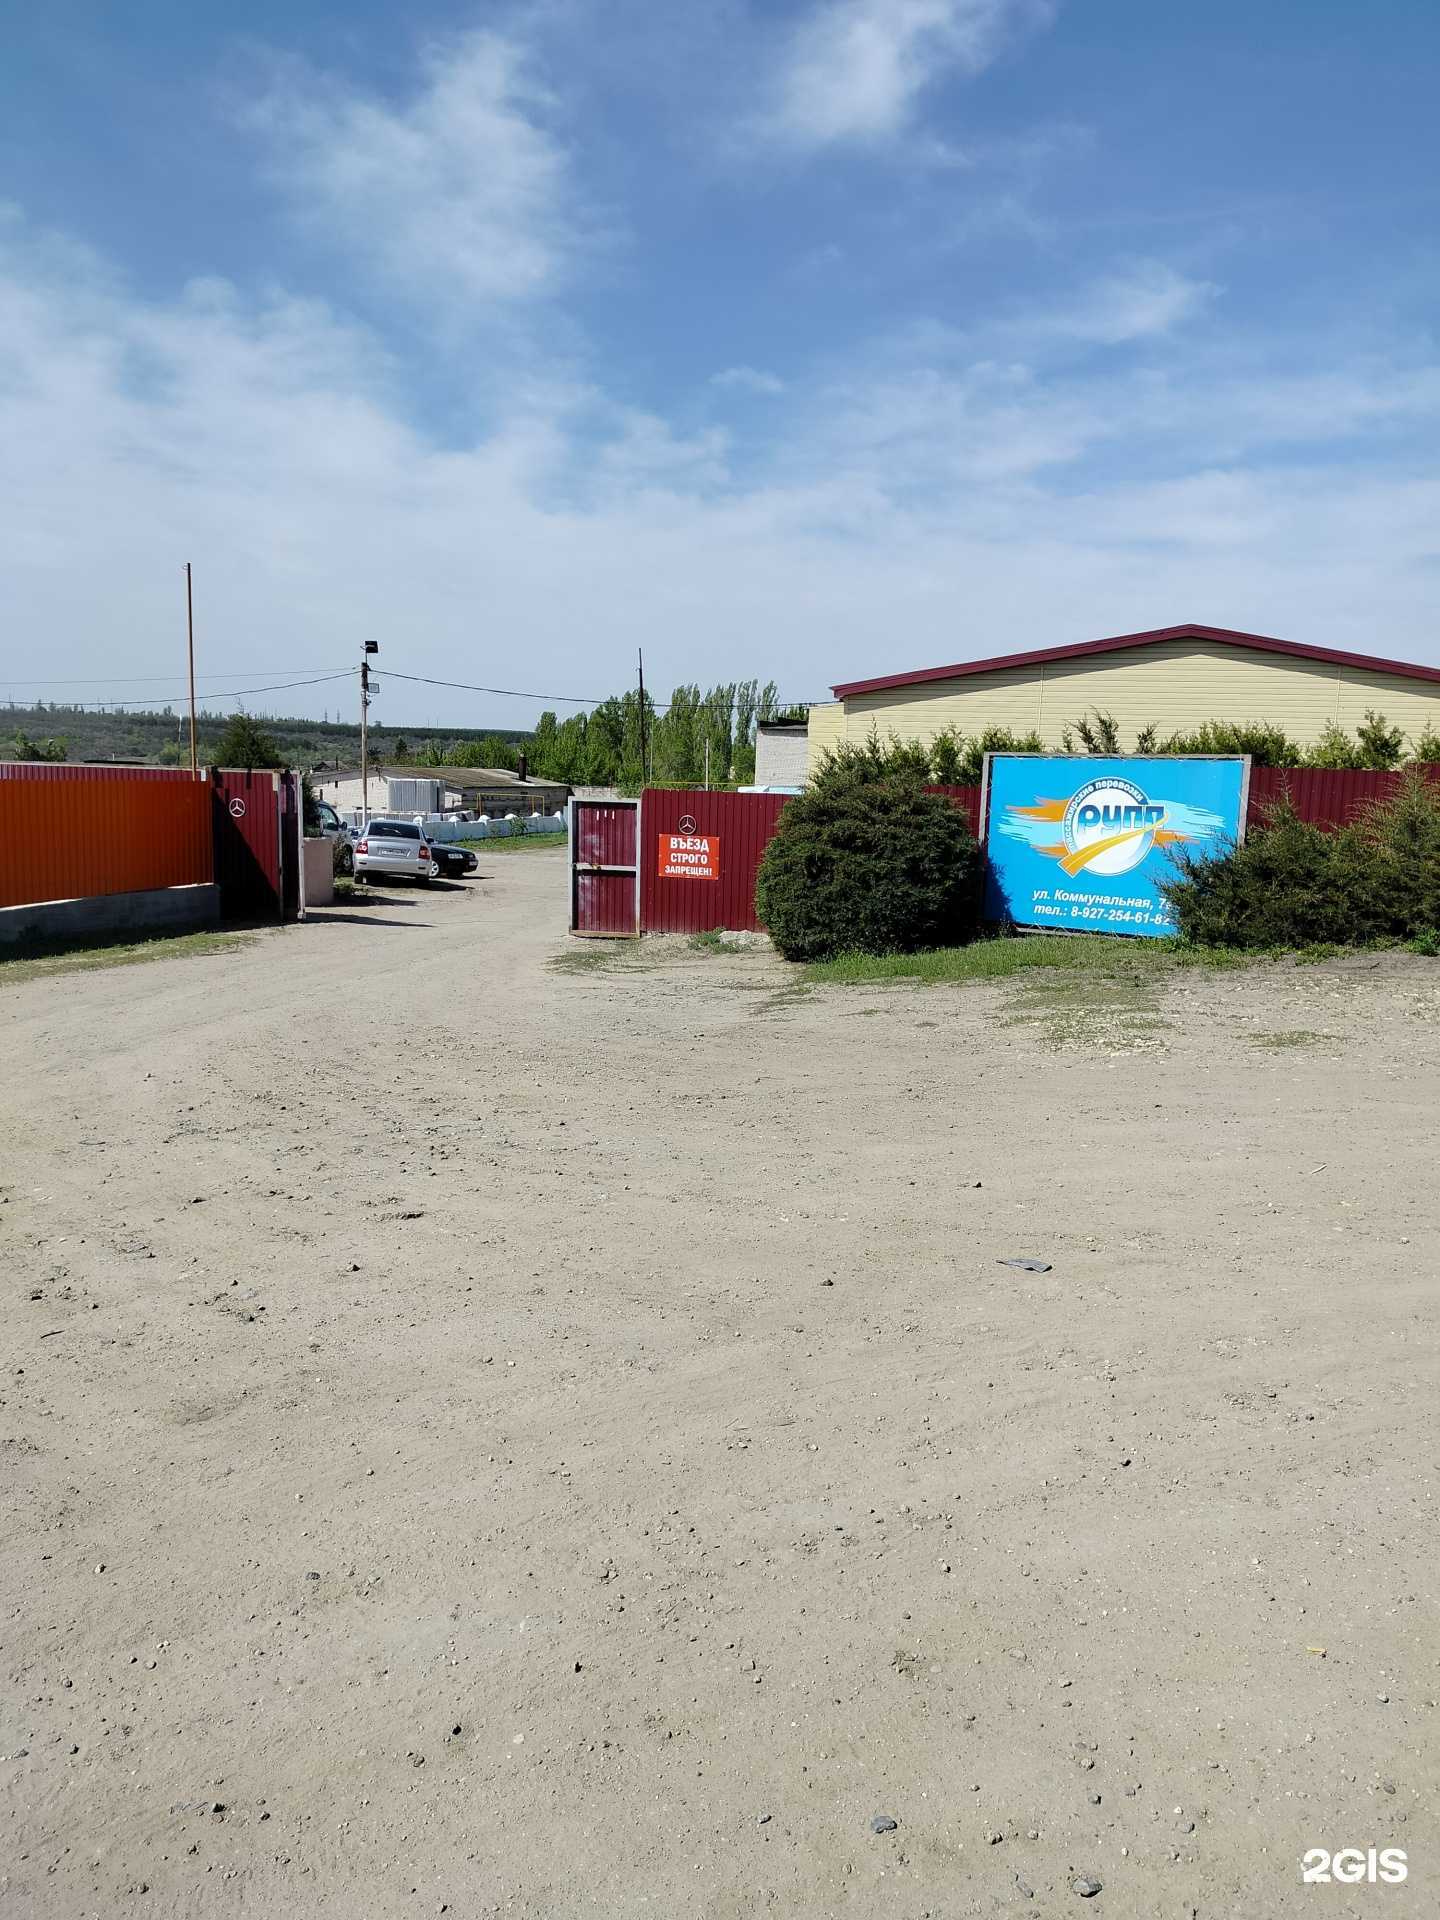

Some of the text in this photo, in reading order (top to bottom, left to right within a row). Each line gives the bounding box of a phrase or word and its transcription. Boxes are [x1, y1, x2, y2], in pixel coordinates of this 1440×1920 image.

[1095, 780, 1143, 801] перевозки
[670, 837, 709, 852] ВЪЕЗД
[670, 853, 708, 864] СТРОГО
[664, 865, 712, 876] ЗАПРЕЩЕН!
[1032, 889, 1050, 901] ул.
[1054, 889, 1153, 910] Коммунальная,
[1034, 904, 1067, 916] тел.:
